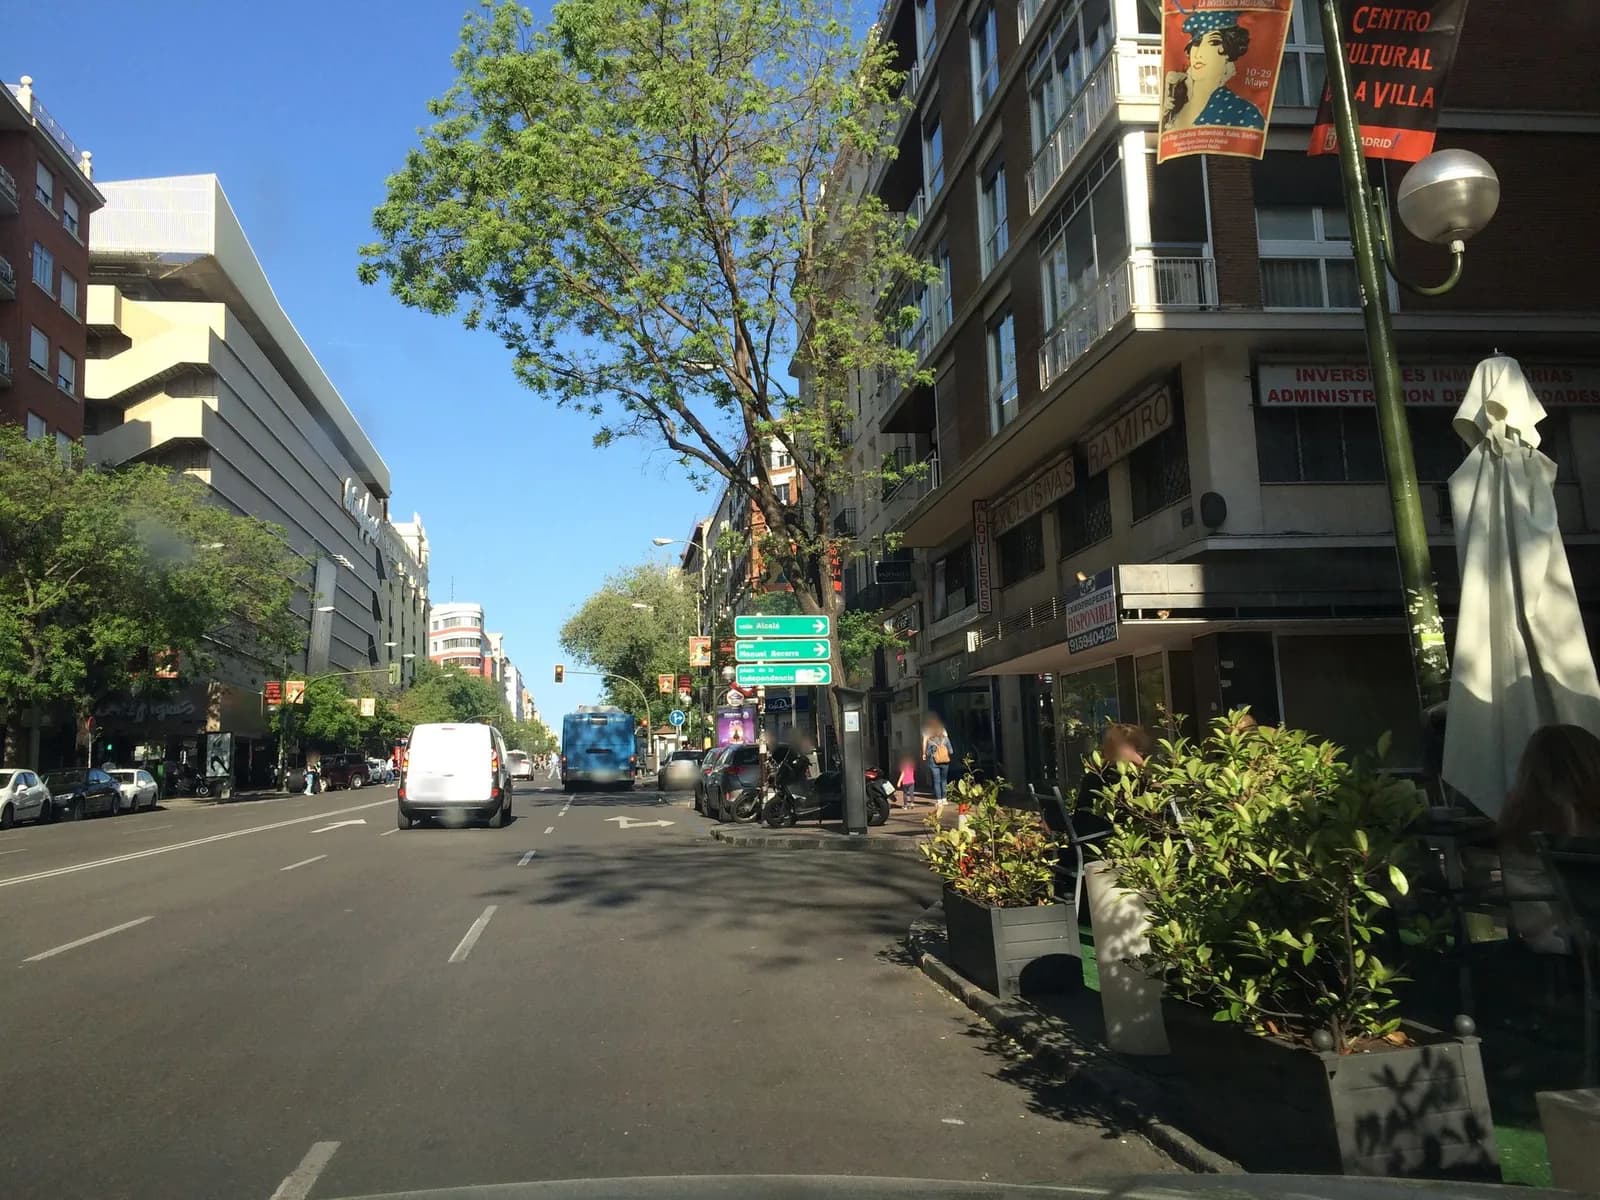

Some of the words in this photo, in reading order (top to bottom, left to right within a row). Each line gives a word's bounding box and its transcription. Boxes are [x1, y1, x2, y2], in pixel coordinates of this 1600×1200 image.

[1352, 6, 1431, 33] CENTRO
[1345, 43, 1433, 70] ULTURAL
[1244, 77, 1269, 89] Mayo
[1246, 67, 1272, 78] 10-29
[1373, 81, 1435, 109] VILLA
[1361, 136, 1392, 149] ADRID
[1088, 391, 1169, 473] RAMIRO
[991, 461, 1073, 530] EXCLUSIVAS
[976, 502, 990, 611] ALQUILERES
[1068, 602, 1115, 633] DISPONIBLE
[739, 650, 767, 658] Manuel
[739, 674, 795, 683] Independencia
